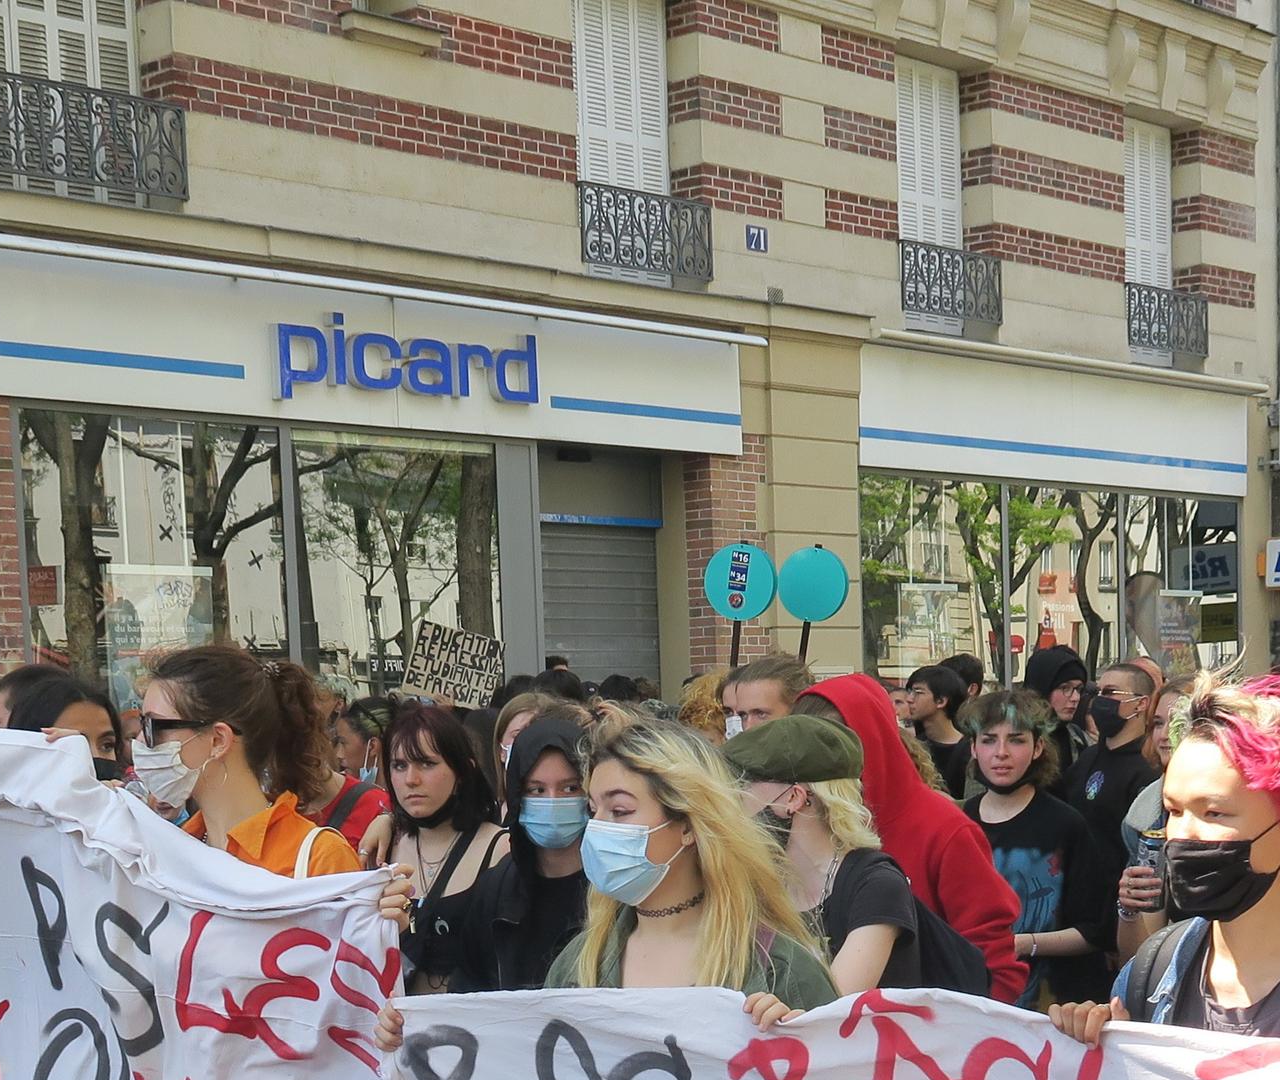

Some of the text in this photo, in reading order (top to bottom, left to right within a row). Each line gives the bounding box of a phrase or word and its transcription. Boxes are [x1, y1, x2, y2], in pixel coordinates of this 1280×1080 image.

[750, 227, 766, 251] 71
[273, 312, 539, 404] picard
[21, 856, 170, 1058] PS
[175, 911, 400, 1078] LES
